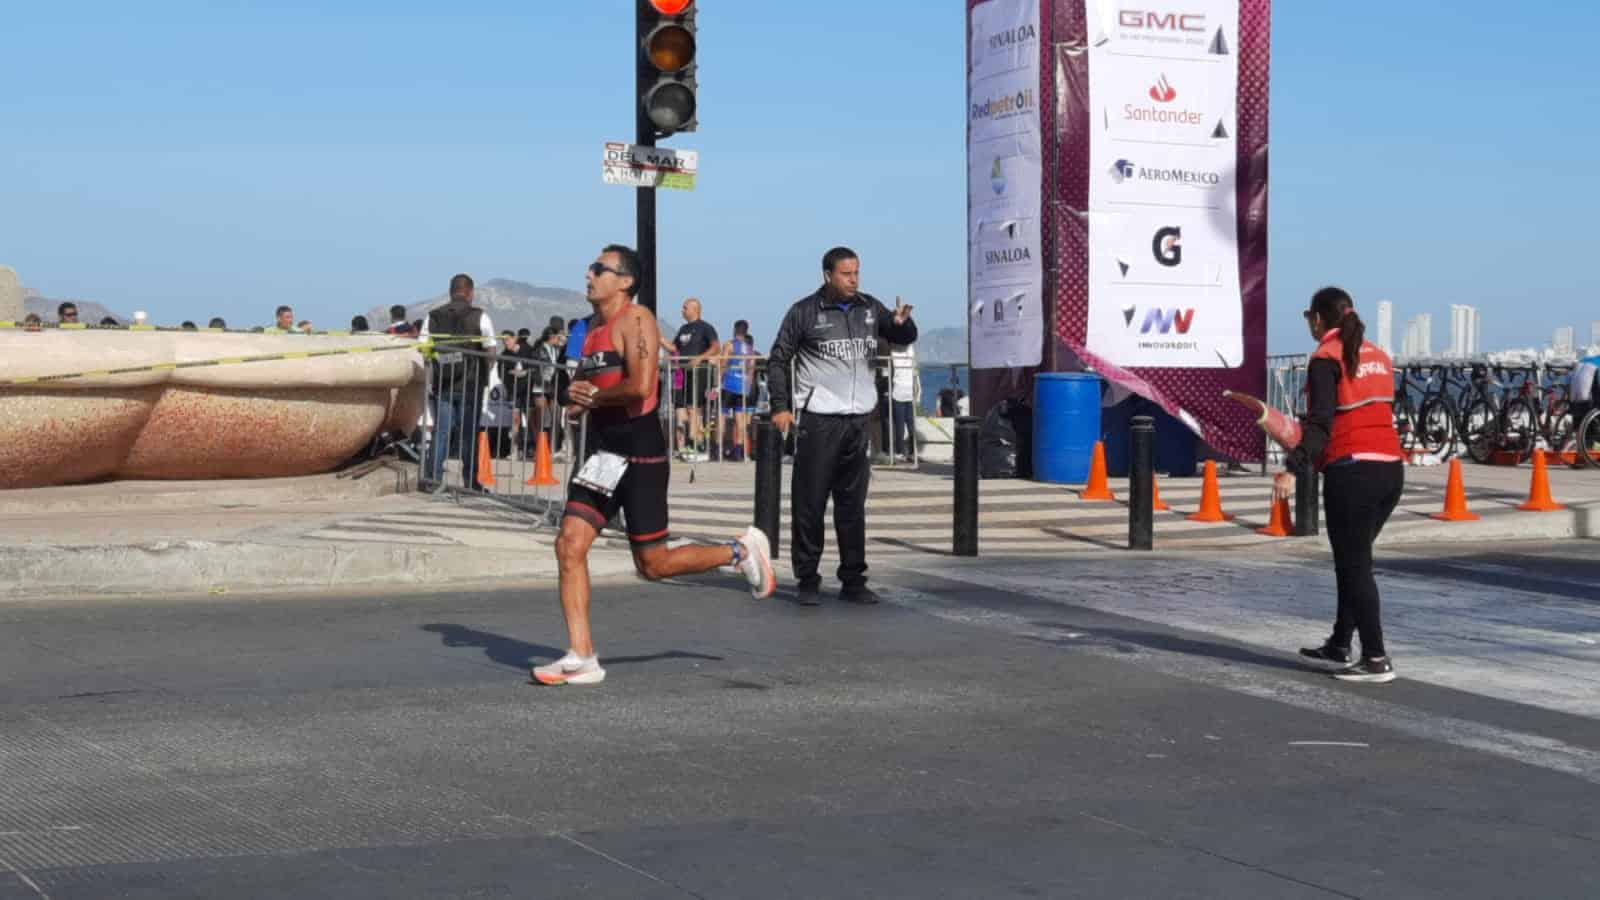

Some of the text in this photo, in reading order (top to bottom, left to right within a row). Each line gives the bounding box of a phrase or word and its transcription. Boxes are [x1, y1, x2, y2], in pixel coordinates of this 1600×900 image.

[1118, 9, 1207, 32] GMC
[989, 24, 1036, 49] SINALOA
[1123, 103, 1203, 125] Santander
[607, 150, 685, 169] DEL MAR
[984, 246, 1032, 265] SINALOA
[1152, 225, 1182, 268] G
